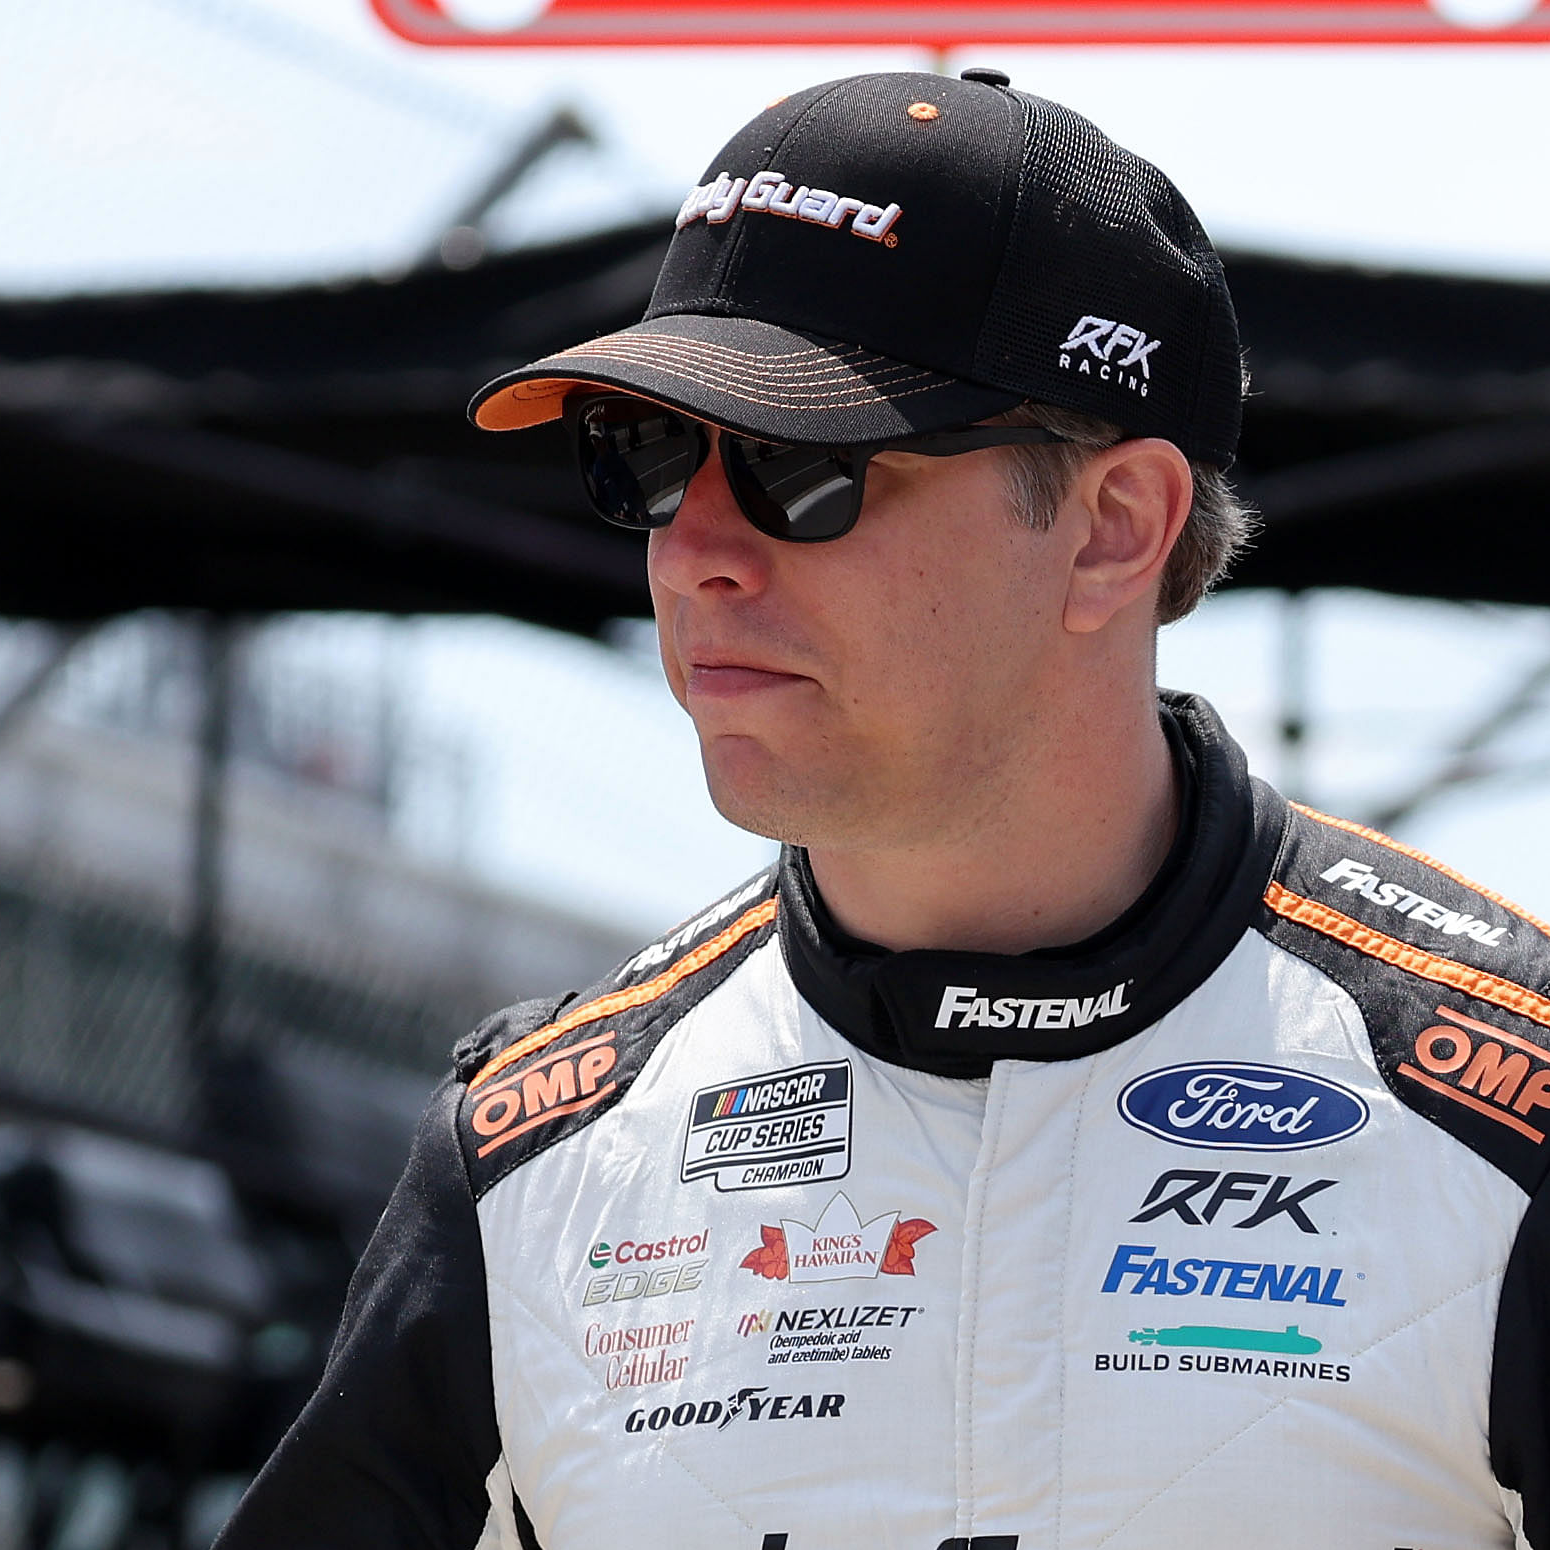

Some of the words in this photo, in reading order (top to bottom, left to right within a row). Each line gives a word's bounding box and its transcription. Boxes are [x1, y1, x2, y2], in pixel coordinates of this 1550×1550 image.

[742, 171, 903, 242] Guard
[1058, 315, 1162, 380] RFK
[1058, 352, 1149, 398] RACING
[1319, 856, 1510, 948] FASTENAL
[933, 981, 1132, 1030] FASTENAL
[471, 1044, 617, 1137] OMP
[740, 1073, 827, 1114] NASCAR
[1167, 1073, 1320, 1134] Ford
[704, 1126, 752, 1154] CUP
[751, 1113, 826, 1149] SERIES
[741, 1158, 825, 1184] CHAMPION
[1127, 1168, 1340, 1235] RFK
[615, 1228, 710, 1265] Castrol
[794, 1251, 879, 1269] HAWAIIAN
[811, 1233, 863, 1253] KING'S
[582, 1258, 711, 1308] EDGE
[1100, 1243, 1347, 1308] FASTENAL
[584, 1319, 695, 1358] Consumer
[769, 1332, 836, 1351] (bempedoic
[837, 1329, 862, 1345] acid
[774, 1306, 917, 1333] NEXLIZET
[605, 1348, 690, 1391] Cellular
[767, 1350, 791, 1365] and
[791, 1348, 850, 1364] ezetimibe)
[850, 1346, 892, 1360] tablets
[1094, 1353, 1170, 1372] BUILD
[1178, 1354, 1351, 1383] SUBMARINES
